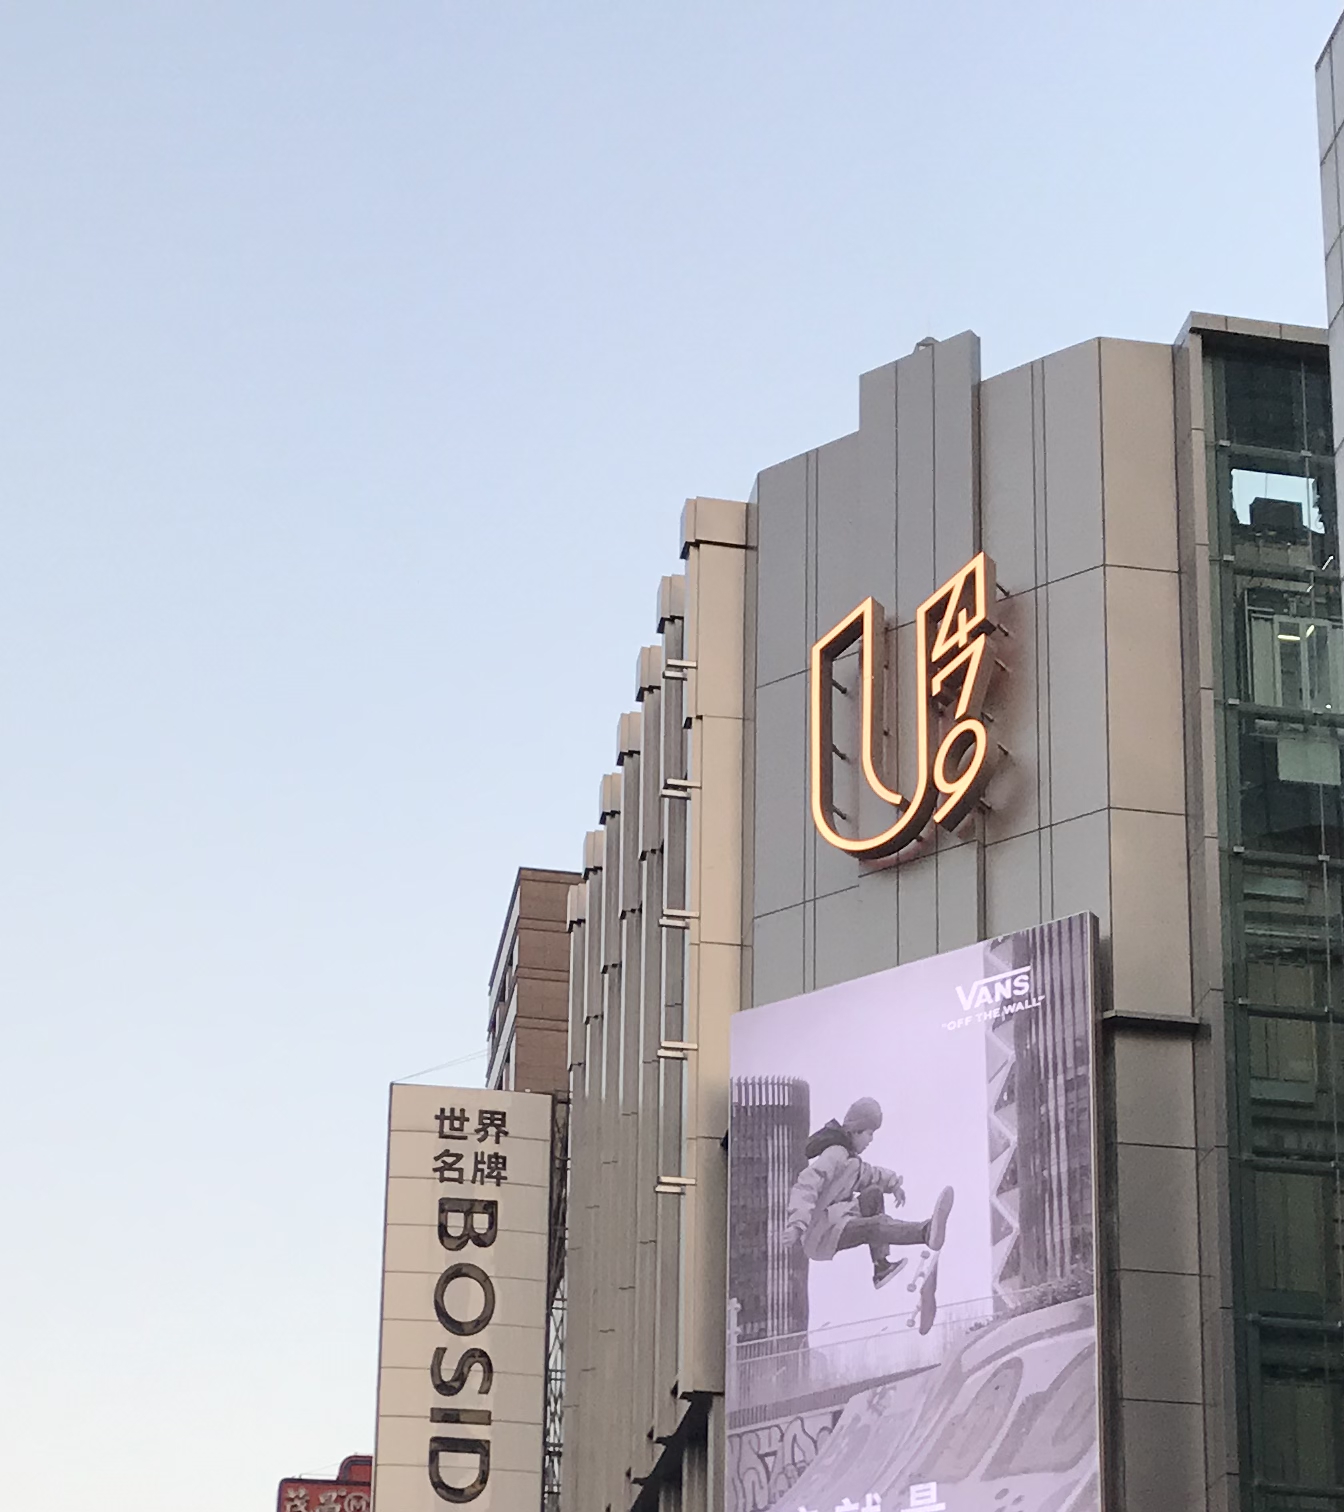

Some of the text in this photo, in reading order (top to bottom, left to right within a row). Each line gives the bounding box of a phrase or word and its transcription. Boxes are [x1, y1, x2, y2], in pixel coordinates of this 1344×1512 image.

[955, 964, 1032, 1011] VANS
[976, 1007, 1001, 1022] THE
[434, 1107, 509, 1145] 世界
[432, 1149, 508, 1187] 名牌
